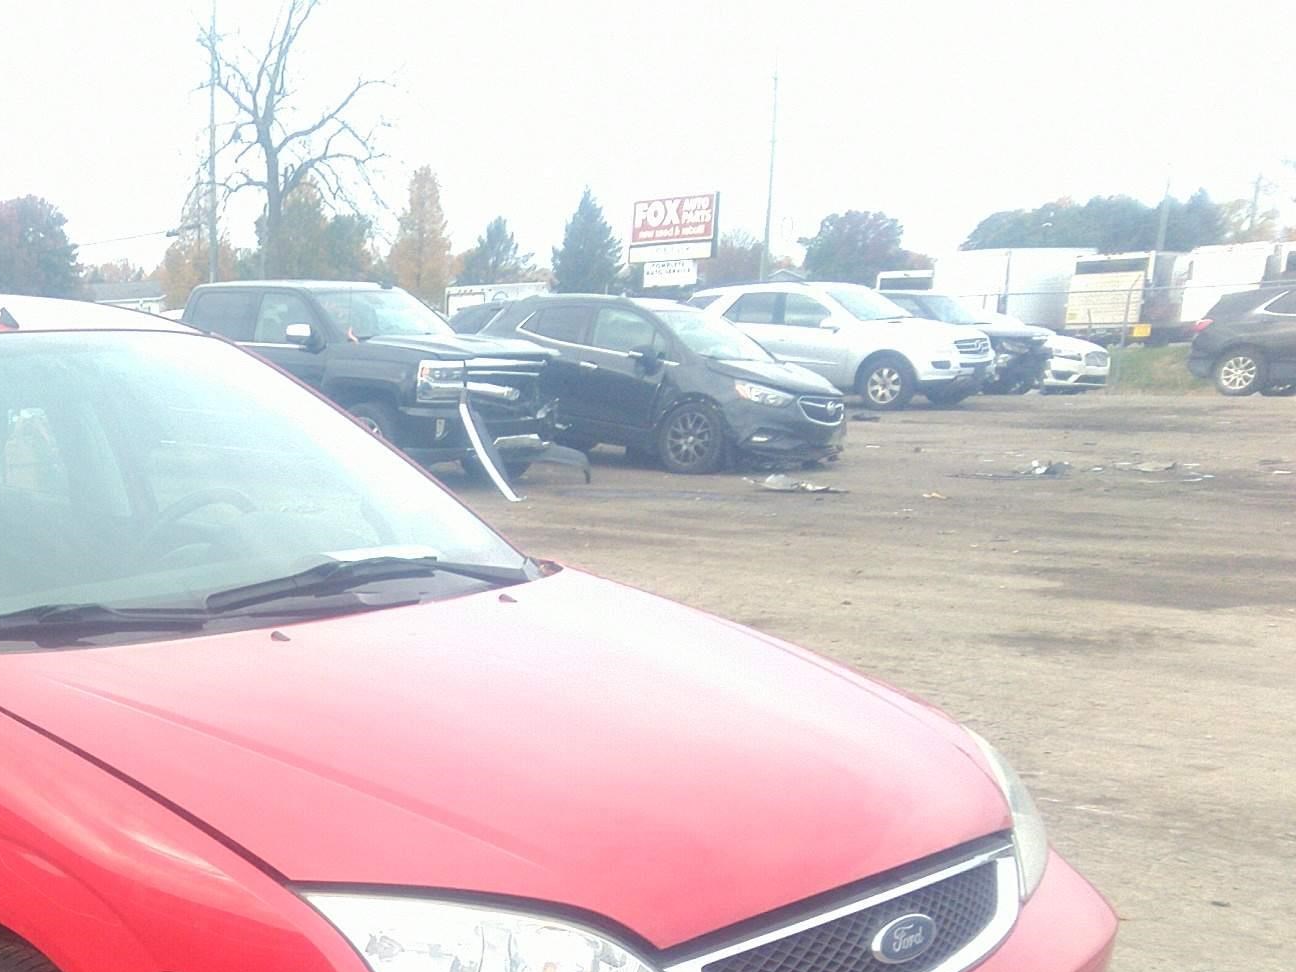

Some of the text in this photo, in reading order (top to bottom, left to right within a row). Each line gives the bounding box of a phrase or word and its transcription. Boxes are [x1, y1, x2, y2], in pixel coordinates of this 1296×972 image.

[635, 199, 682, 228] FOX
[684, 197, 709, 210] AUTO
[683, 208, 712, 224] PARTS
[892, 923, 924, 953] Ford
